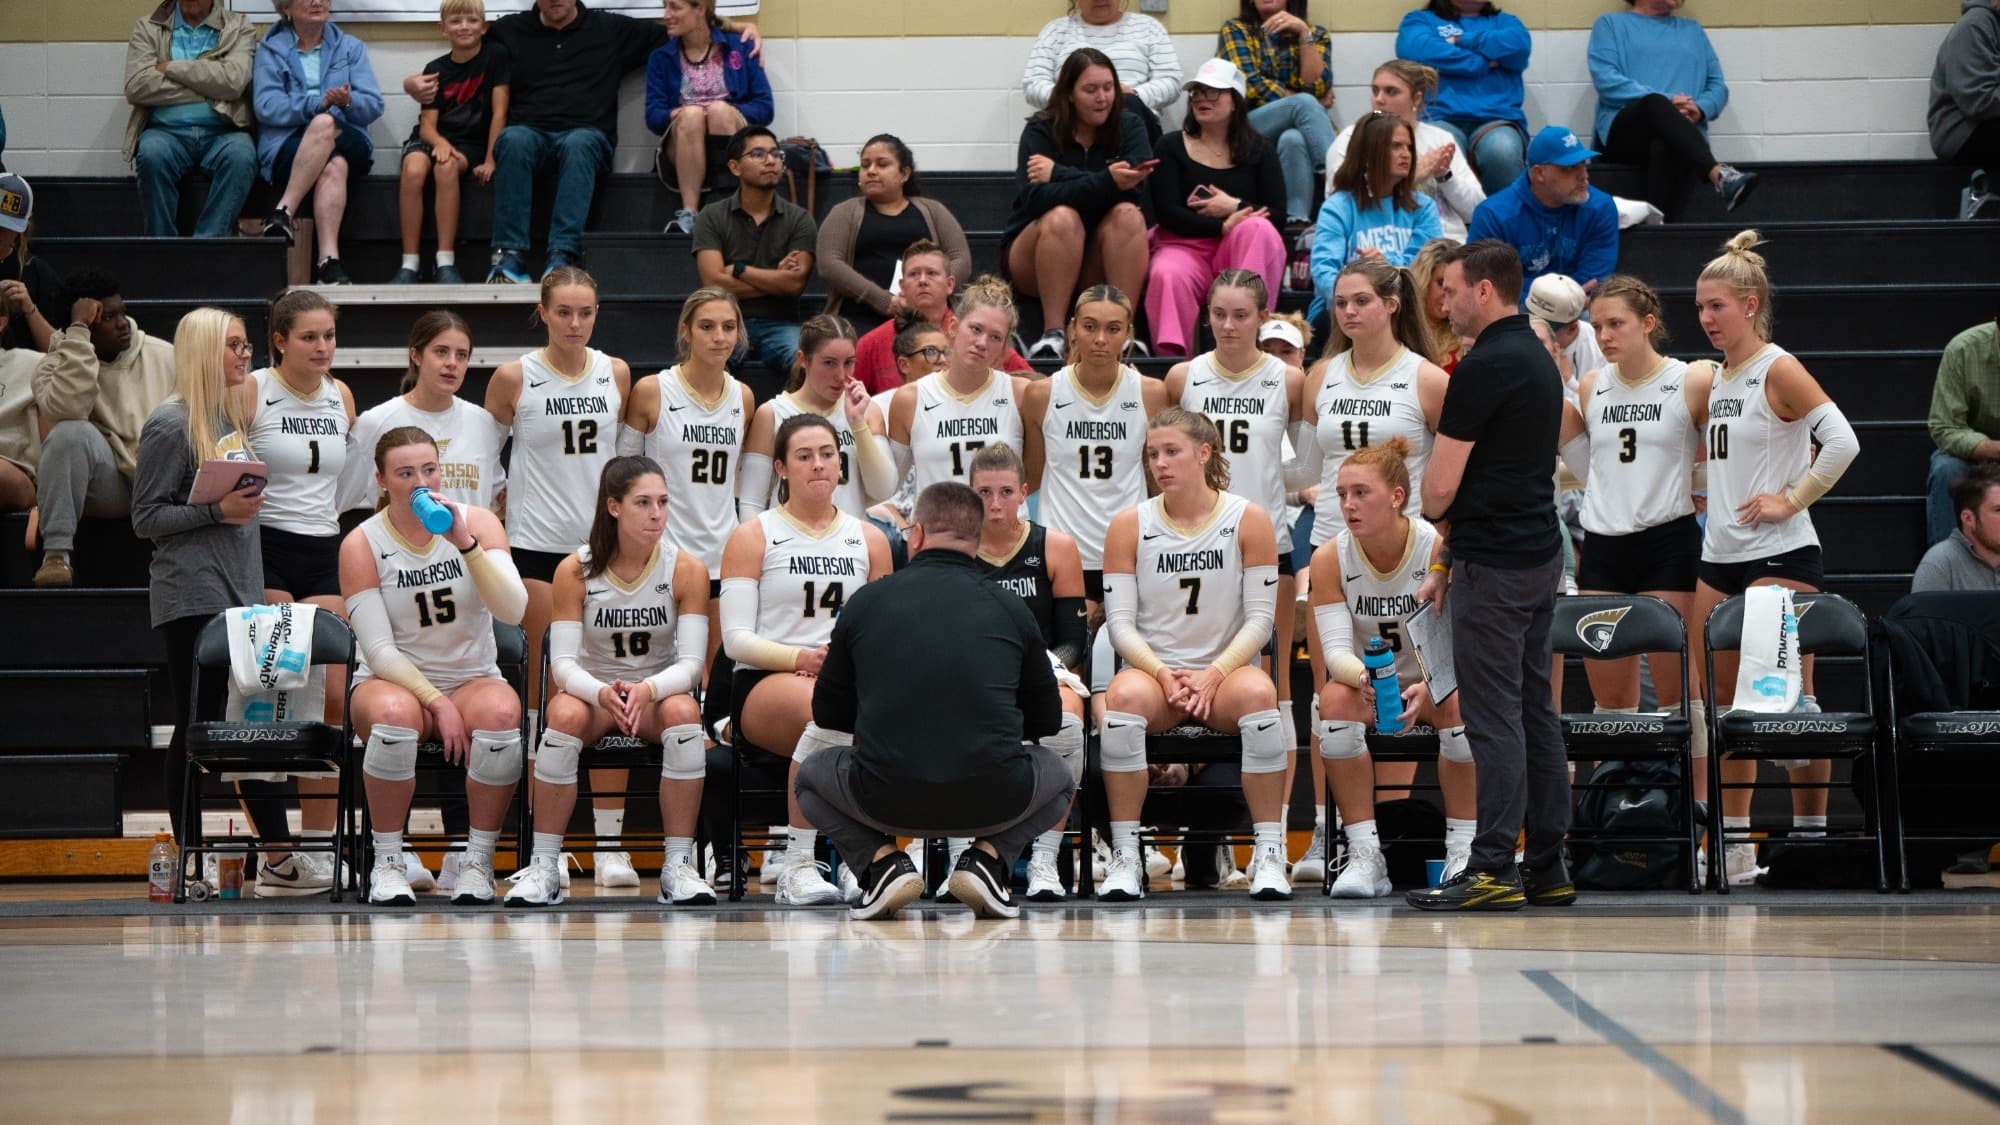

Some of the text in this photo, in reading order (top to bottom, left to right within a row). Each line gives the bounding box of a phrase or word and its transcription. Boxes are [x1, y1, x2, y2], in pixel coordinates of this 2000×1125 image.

[1391, 382, 1408, 391] SAC
[545, 396, 608, 416] ANDERSON
[1121, 401, 1139, 411] SAC
[1202, 397, 1265, 416] ANDERSON
[1328, 398, 1391, 417] ANDERSON
[1602, 403, 1662, 424] ANDERSON
[281, 416, 339, 436] ANDERSON
[561, 419, 598, 455] 12
[682, 424, 737, 446] ANDERSON
[936, 417, 998, 438] ANDERSON
[1066, 420, 1127, 441] ANDERSON
[1219, 419, 1250, 455] 16
[1341, 420, 1369, 450] 11
[1619, 427, 1638, 463] 3
[1709, 423, 1729, 461] 10
[306, 440, 320, 474] 1
[691, 448, 729, 485] 20
[1078, 445, 1114, 480] 13
[789, 555, 855, 577] ANDERSON
[1156, 549, 1224, 573] ANDERSON
[396, 558, 463, 589] ANDERSON
[413, 586, 457, 629] 15
[802, 580, 844, 619] 14
[1179, 577, 1201, 615] 7
[1354, 592, 1420, 618] ANDERSON
[593, 605, 668, 629] ANDERSON
[1376, 621, 1402, 651] 5
[207, 729, 299, 743] TROJANS
[1570, 721, 1664, 735] TROJANS
[1753, 721, 1847, 735] TROJANS
